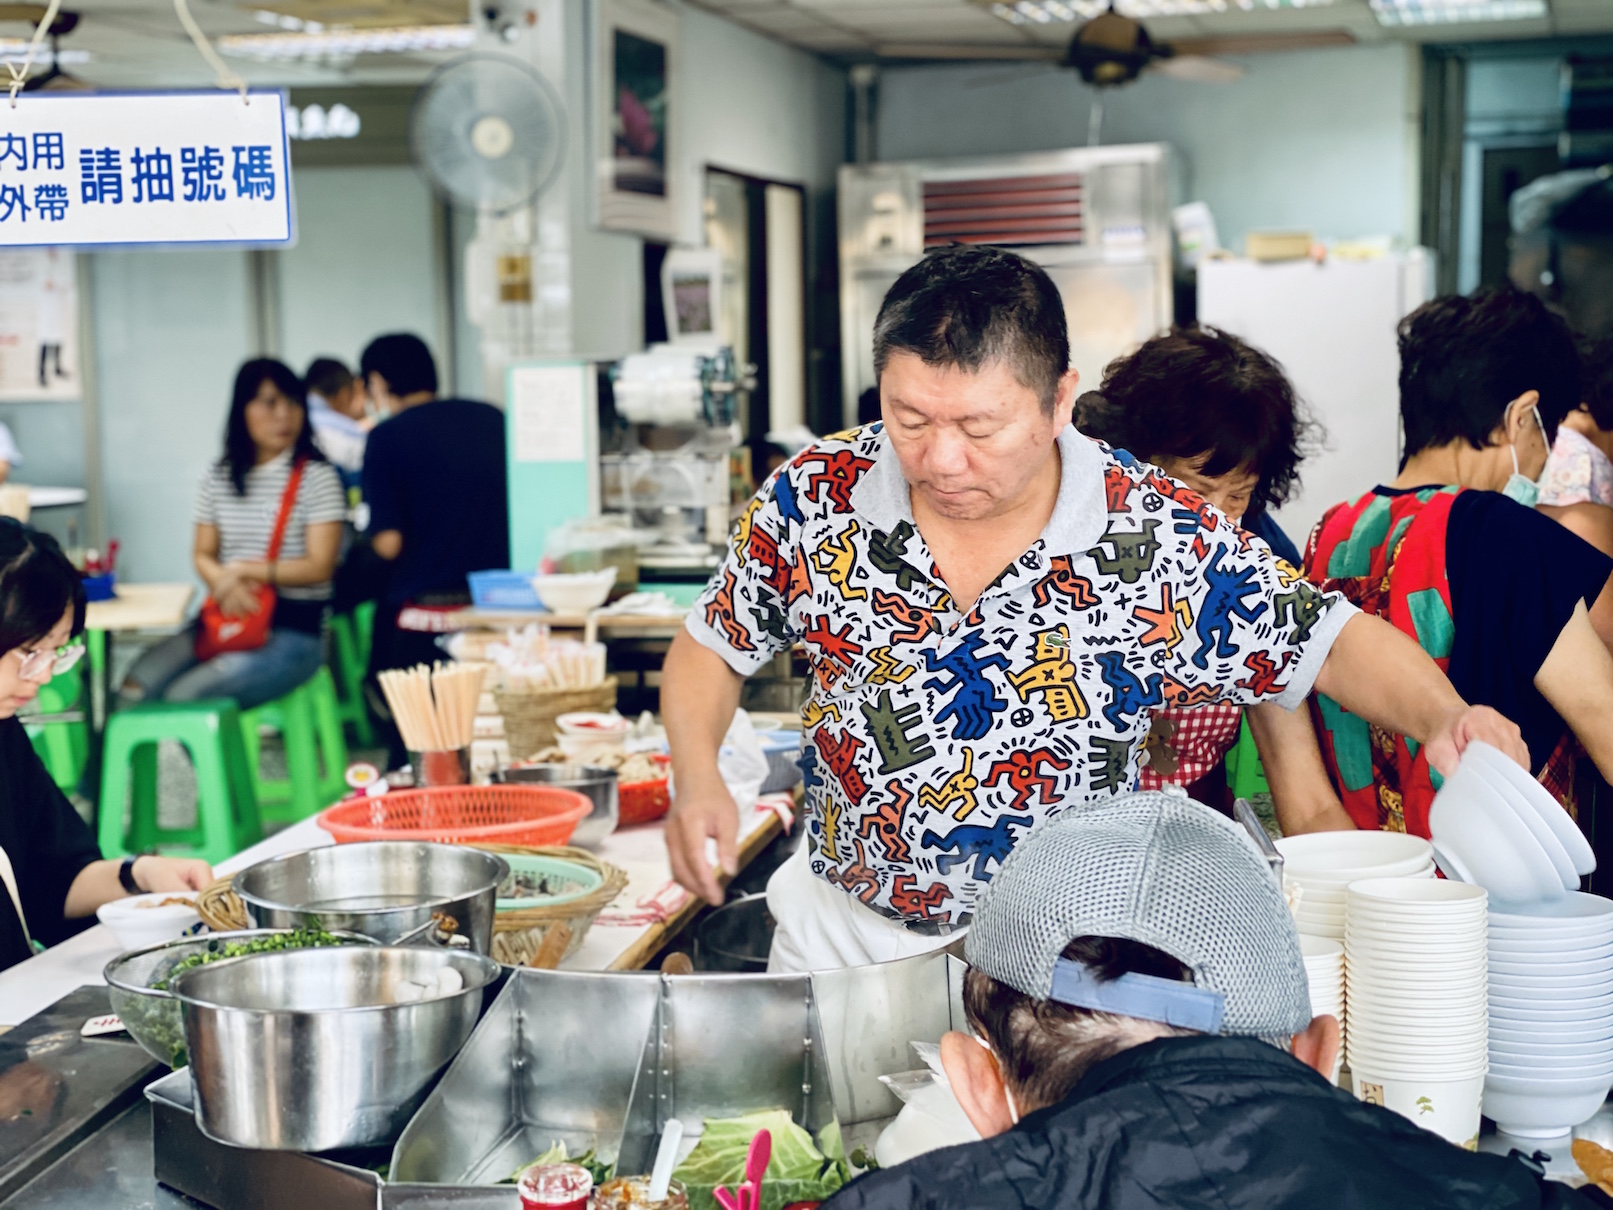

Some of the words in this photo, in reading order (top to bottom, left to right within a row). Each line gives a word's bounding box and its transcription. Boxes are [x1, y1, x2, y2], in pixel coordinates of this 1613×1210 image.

[78, 145, 276, 204] 請抽號碼
[0, 184, 69, 222] 外帶
